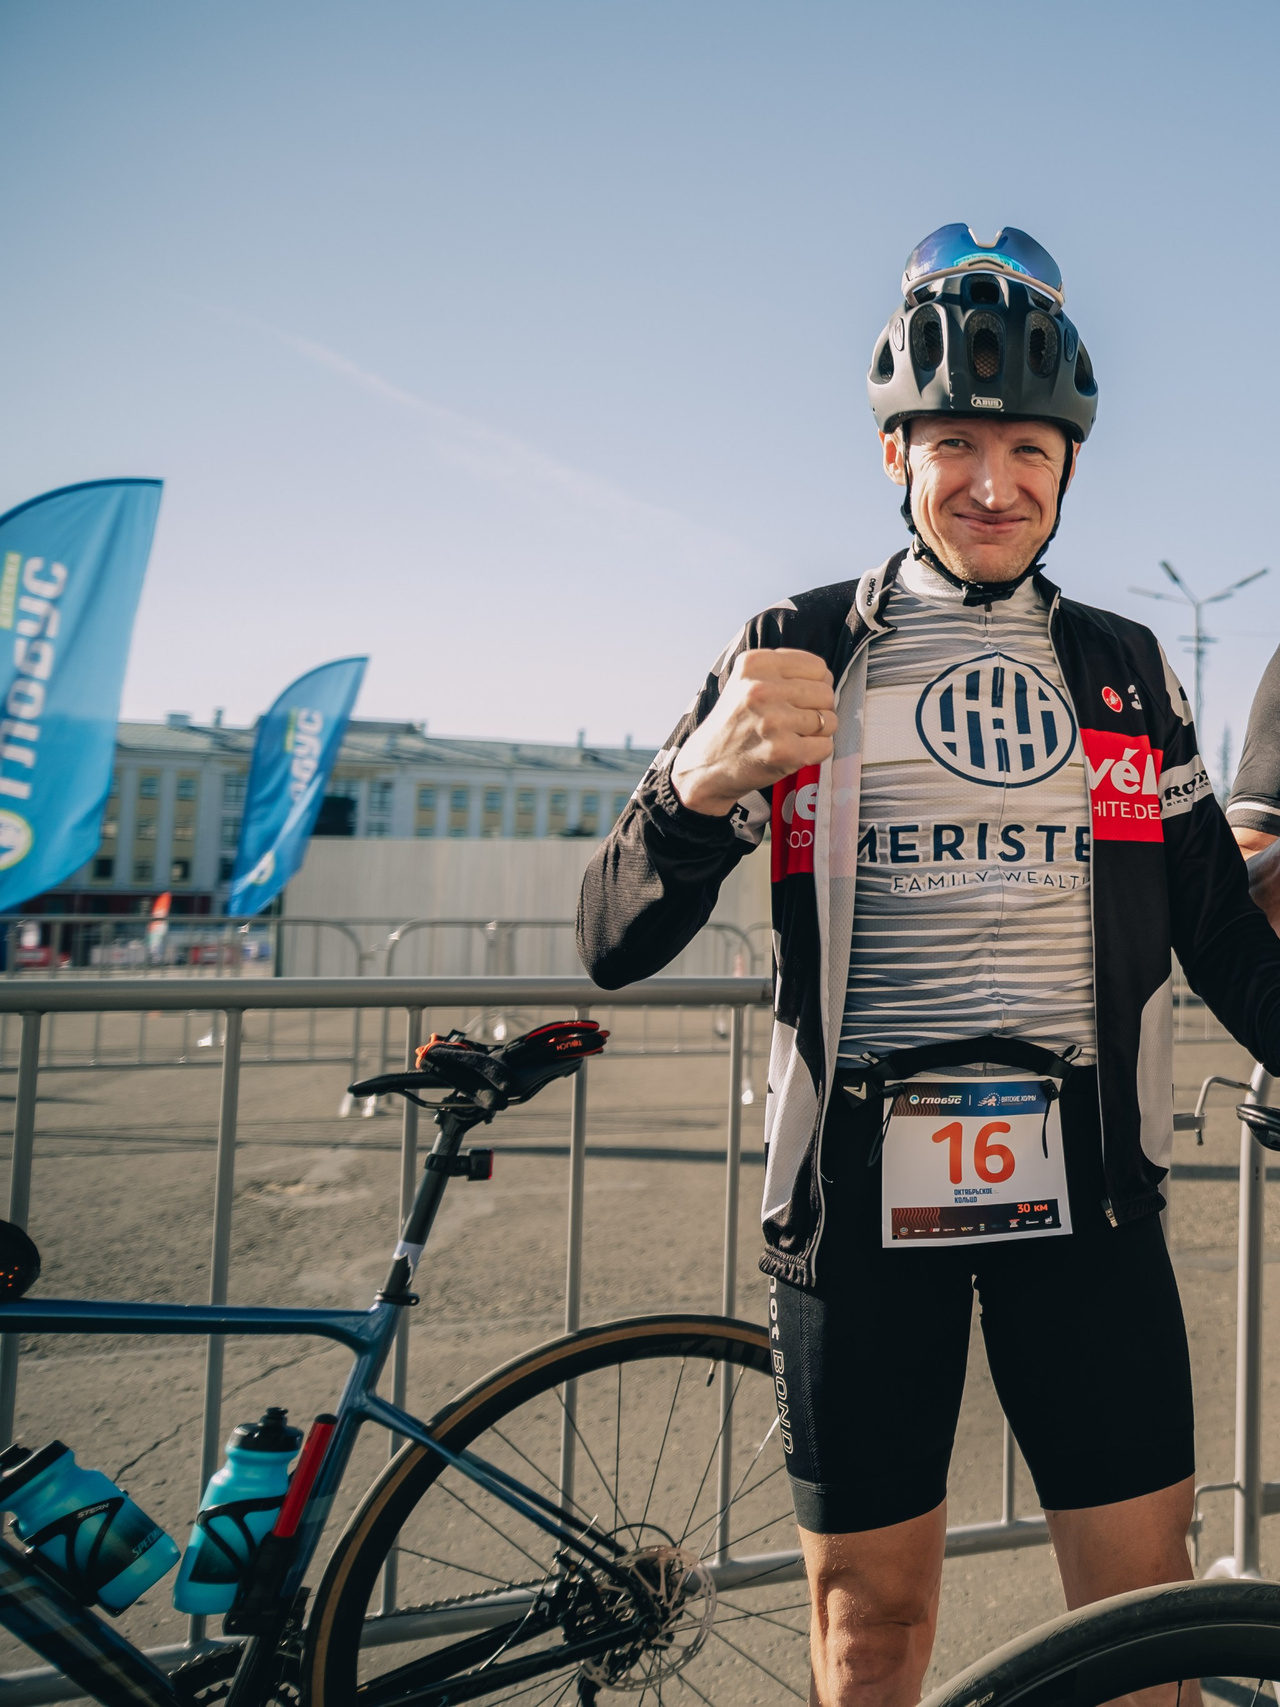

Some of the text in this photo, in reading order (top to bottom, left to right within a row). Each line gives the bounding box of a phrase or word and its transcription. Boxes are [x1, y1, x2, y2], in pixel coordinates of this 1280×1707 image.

[974, 398, 1000, 408] ABUS
[893, 871, 989, 892] FAMILY
[921, 1096, 962, 1105] ГЛОБУС
[932, 1121, 1016, 1185] 16
[954, 1188, 993, 1196] ОКТЯБРЬСКОЕ
[954, 1196, 978, 1204] КОЛЬЦО
[1017, 1203, 1031, 1214] 30
[772, 1349, 794, 1455] BOND
[77, 1503, 110, 1519] STERN
